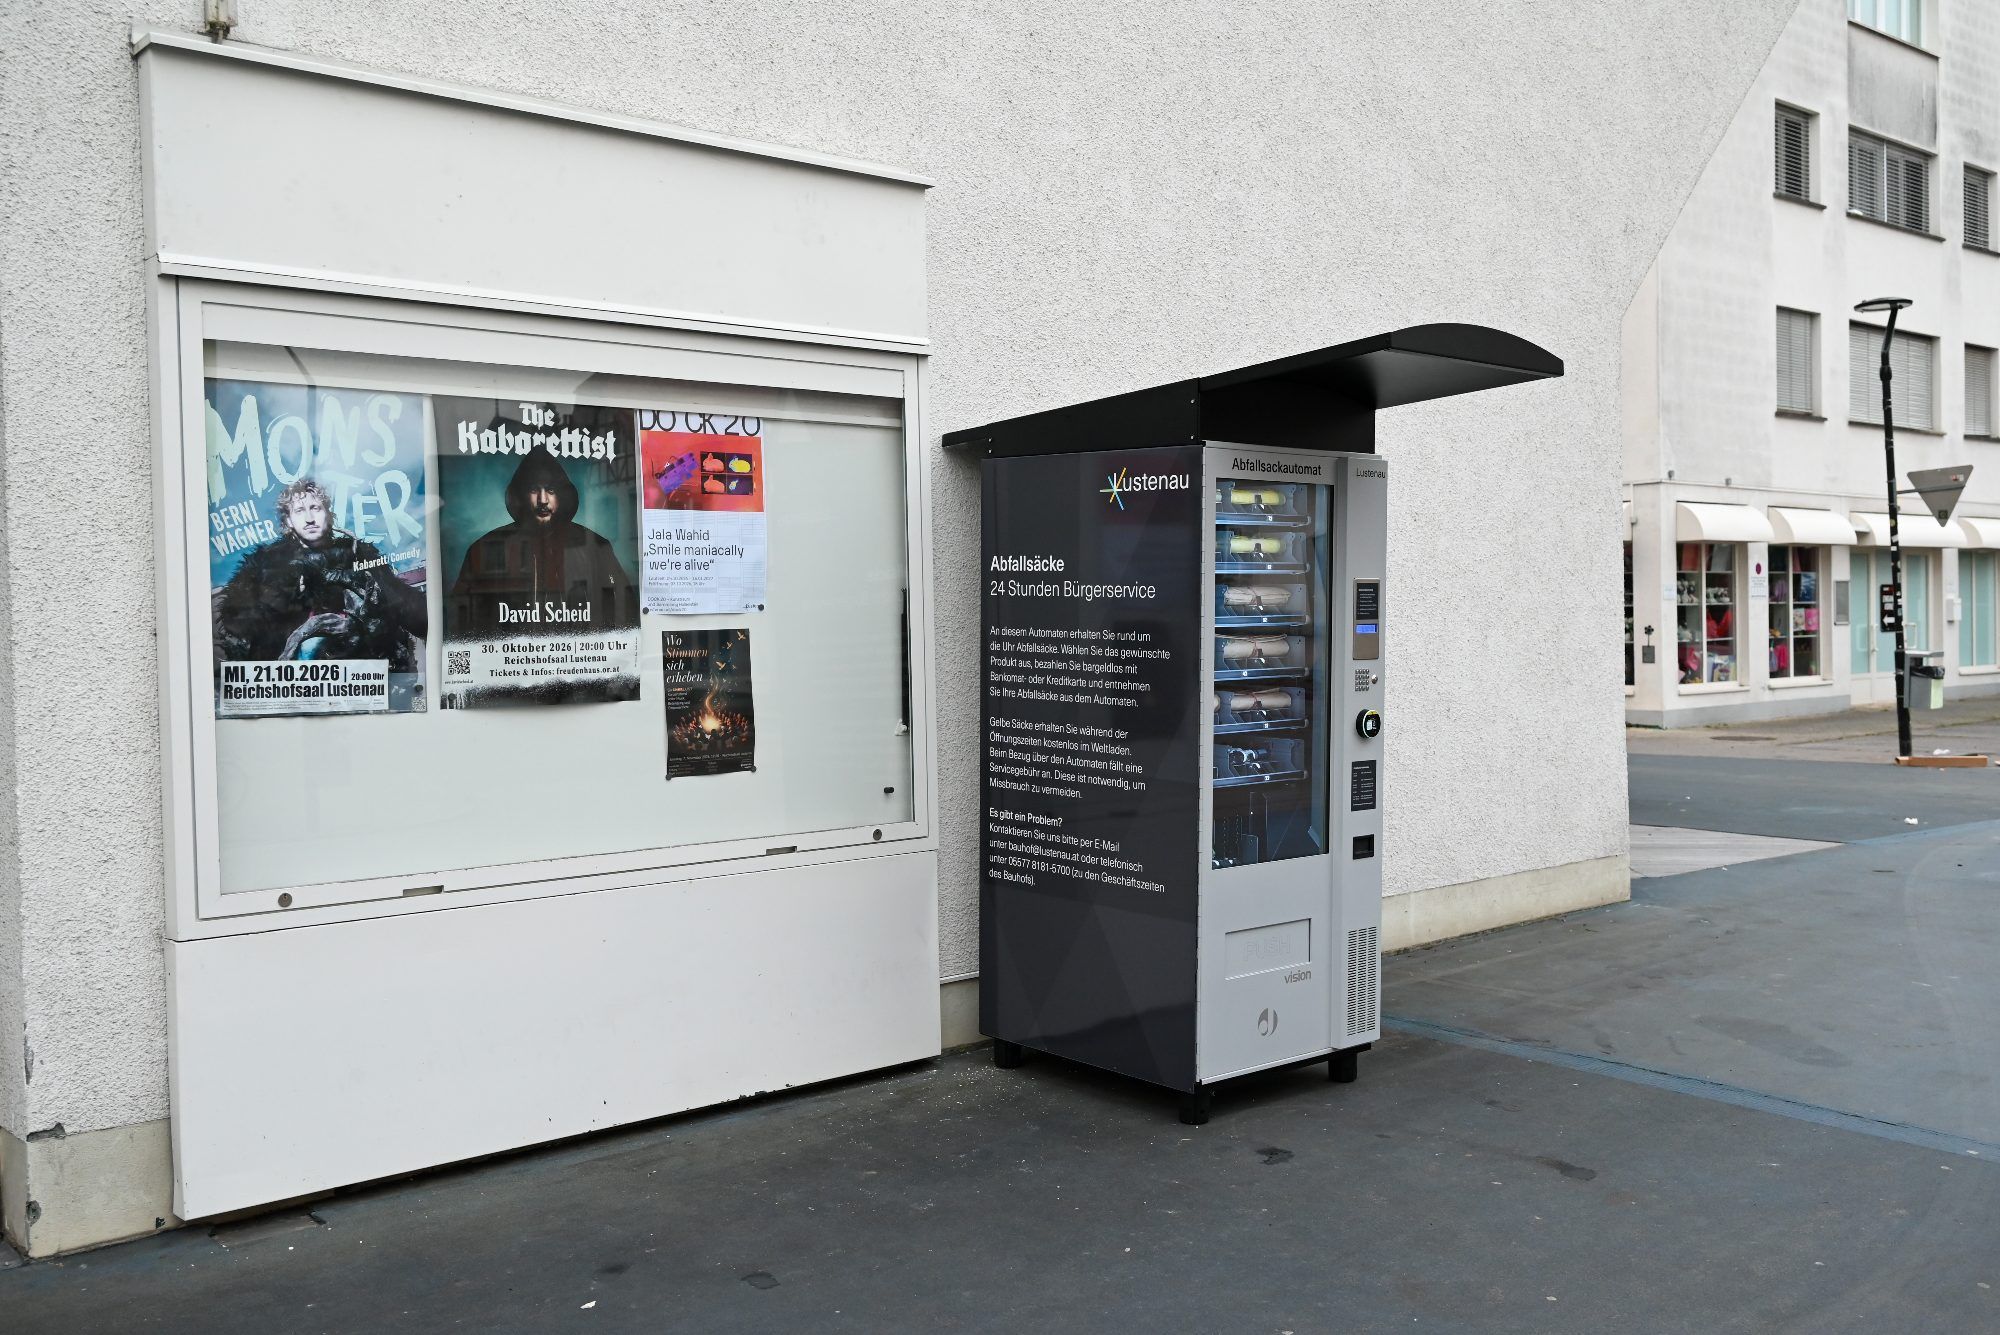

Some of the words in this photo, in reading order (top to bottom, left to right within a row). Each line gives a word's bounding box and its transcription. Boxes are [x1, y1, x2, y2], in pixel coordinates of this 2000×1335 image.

[519, 402, 555, 430] The
[204, 394, 402, 507] MONS
[457, 420, 616, 464] Kabarettist
[1232, 457, 1322, 476] Abfallsackautomat
[1356, 468, 1386, 479] Lustenau
[1105, 471, 1189, 496] Lustenau
[210, 500, 259, 532] BERNI
[210, 520, 278, 557] WAGNER
[648, 529, 672, 540] Jala
[676, 529, 710, 540] Wahid
[684, 545, 744, 558] maniacally
[990, 555, 1065, 572] Abfallsäcke
[990, 581, 1005, 596] 24
[1008, 580, 1059, 597] Stunden
[1063, 580, 1156, 601] Bürgerservice
[499, 602, 540, 623] David
[545, 602, 591, 622] Scheid
[666, 634, 682, 646] Wo
[990, 625, 1000, 636] An
[1001, 626, 1027, 637] diesem
[1028, 627, 1068, 638] Automaten
[1069, 628, 1101, 639] erhalten
[1102, 629, 1115, 640] Sie
[1117, 630, 1136, 641] rund
[1137, 633, 1151, 642] um
[481, 644, 498, 654] 30.
[502, 643, 547, 653] Oktober
[549, 642, 572, 652] 2026
[579, 642, 605, 651] 20:00
[607, 640, 628, 651] Uhr
[666, 647, 708, 658] Stimmen
[990, 641, 1001, 651] die
[1002, 641, 1015, 651] Uhr
[1016, 642, 1060, 654] Abfallsäcke.
[1060, 644, 1089, 655] Wählen
[1090, 645, 1103, 656] Sie
[1104, 646, 1119, 657] das
[1120, 647, 1171, 660] gewünschte
[504, 654, 568, 665] Reichshofsaal
[570, 654, 607, 663] Lustenau
[665, 659, 684, 671] sich
[990, 655, 1017, 667] Produkt
[1018, 660, 1033, 669] aus,
[1034, 658, 1068, 669] bezahlen
[1069, 660, 1081, 671] Sie
[1082, 661, 1123, 675] bargeldlos
[1125, 663, 1138, 674] mit
[224, 666, 250, 684] MI,
[253, 664, 340, 683] 21.10.2026
[351, 673, 372, 681] 20:00
[489, 668, 521, 677] Tickets
[522, 669, 529, 677] &
[531, 668, 555, 676] Infos:
[666, 670, 703, 683] erheben
[223, 683, 324, 699] Reichshofsaal
[327, 683, 385, 697] Lustenau
[1028, 674, 1045, 684] oder
[1046, 674, 1087, 687] Kreditkarte
[1088, 679, 1104, 688] und
[1104, 680, 1150, 692] entnehmen
[989, 686, 1001, 697] Sie
[1002, 687, 1016, 697] Ihre
[1017, 688, 1059, 701] Abfallsäcke
[1059, 693, 1073, 702] aus
[1074, 693, 1092, 703] dem
[1093, 693, 1139, 707] Automaten.
[990, 716, 1010, 728] Gelbe
[1011, 718, 1033, 730] Säcke
[1034, 722, 1065, 733] erhalten
[1066, 724, 1078, 734] Sie
[1080, 725, 1113, 738] während
[1114, 728, 1129, 739] der
[989, 730, 1042, 746] Öffnungszeiten
[1043, 737, 1079, 751] kostenlos
[1080, 740, 1090, 752] im
[1091, 742, 1132, 756] Weltladen.
[990, 747, 1008, 758] Beim
[1008, 748, 1031, 763] Bezug
[1032, 751, 1049, 763] über
[1050, 754, 1065, 764] den
[1066, 756, 1108, 770] Automaten
[1109, 760, 1124, 772] fällt
[1125, 762, 1143, 774] eine
[989, 762, 1040, 777] Servicegebühr
[1041, 770, 1053, 779] an.
[1054, 770, 1076, 782] Diese
[1077, 773, 1087, 783] ist
[1088, 776, 1131, 791] notwendig,
[1132, 781, 1146, 791] um
[989, 777, 1030, 791] Missbrauch
[1031, 784, 1040, 793] zu
[1041, 787, 1082, 798] vermeiden.
[989, 807, 998, 818] Es
[999, 810, 1013, 821] gibt
[1014, 812, 1026, 822] ein
[1027, 812, 1063, 827] Problem?
[989, 822, 1033, 838] Kontaktieren
[1033, 829, 1046, 840] Sie
[1047, 833, 1061, 842] uns
[1062, 833, 1079, 846] bitte
[1080, 838, 1094, 848] per
[1094, 839, 1120, 852] E-Mail
[989, 839, 1007, 848] unter
[1081, 853, 1099, 865] oder
[1100, 856, 1143, 872] telefonisch
[989, 854, 1007, 864] unter
[1032, 860, 1071, 876] 8181-5700
[1072, 867, 1083, 878] (zu
[1084, 870, 1100, 881] den
[1101, 872, 1165, 892] Geschäftszeiten
[989, 868, 1002, 879] des
[1284, 970, 1312, 984] vision
